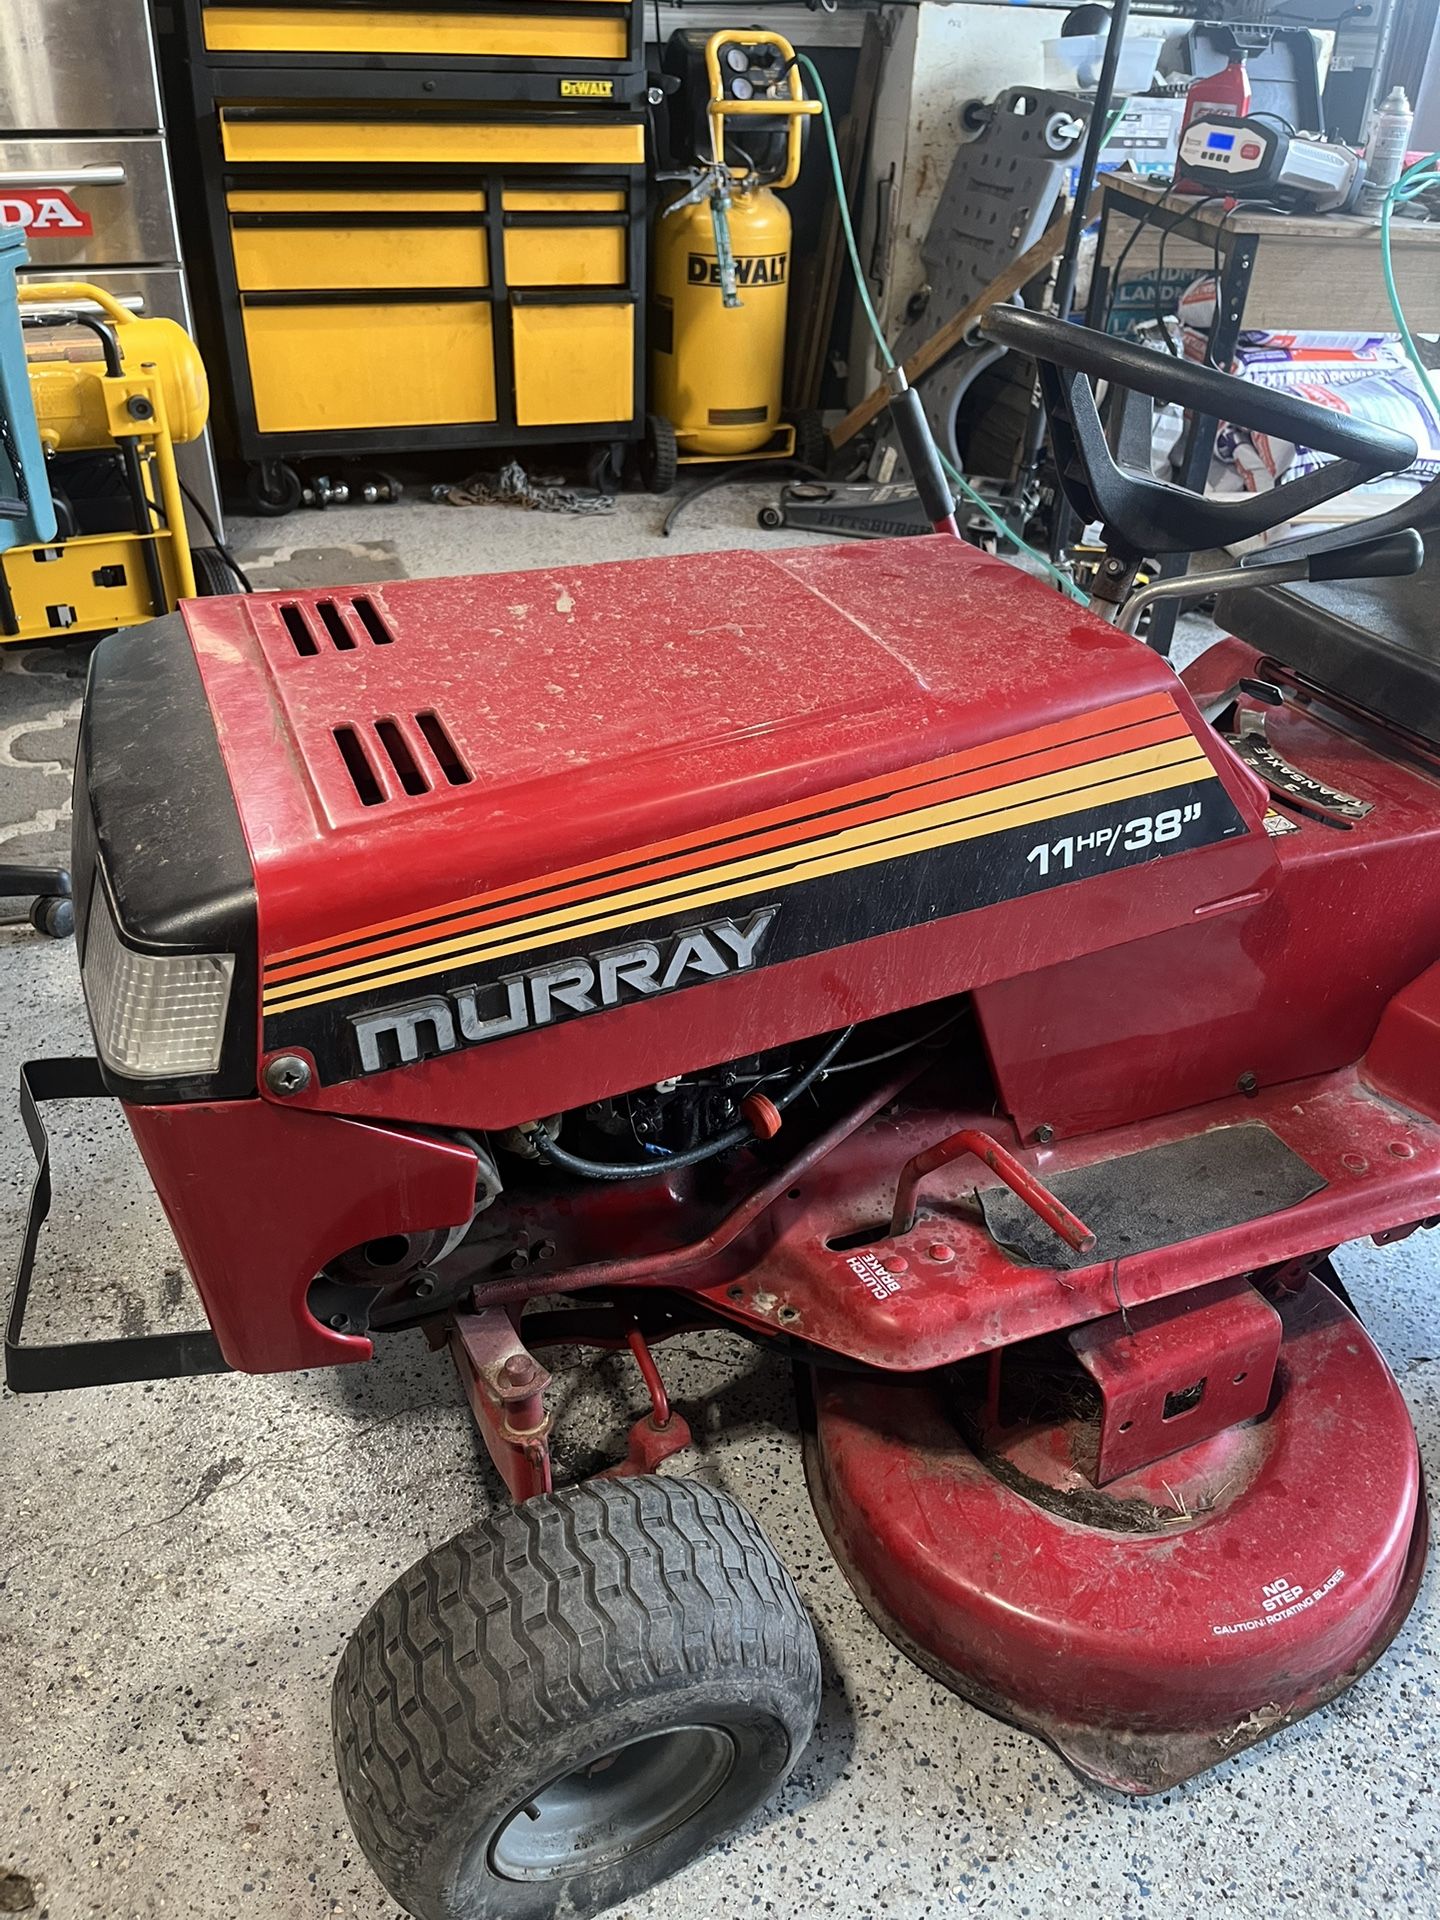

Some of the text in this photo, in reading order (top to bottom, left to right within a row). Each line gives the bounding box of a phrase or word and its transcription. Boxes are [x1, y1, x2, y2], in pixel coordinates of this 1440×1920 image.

[561, 81, 613, 95] DEWALT
[1253, 746, 1364, 809] TRANSAXLE
[347, 903, 781, 1073] MURRAY
[846, 1256, 889, 1300] CLUTCH
[861, 1253, 902, 1293] BRAKE
[1261, 1578, 1290, 1598] NO
[1261, 1585, 1304, 1612] STEP
[1265, 1596, 1314, 1625] ROTATING
[1312, 1568, 1345, 1601] BLADES
